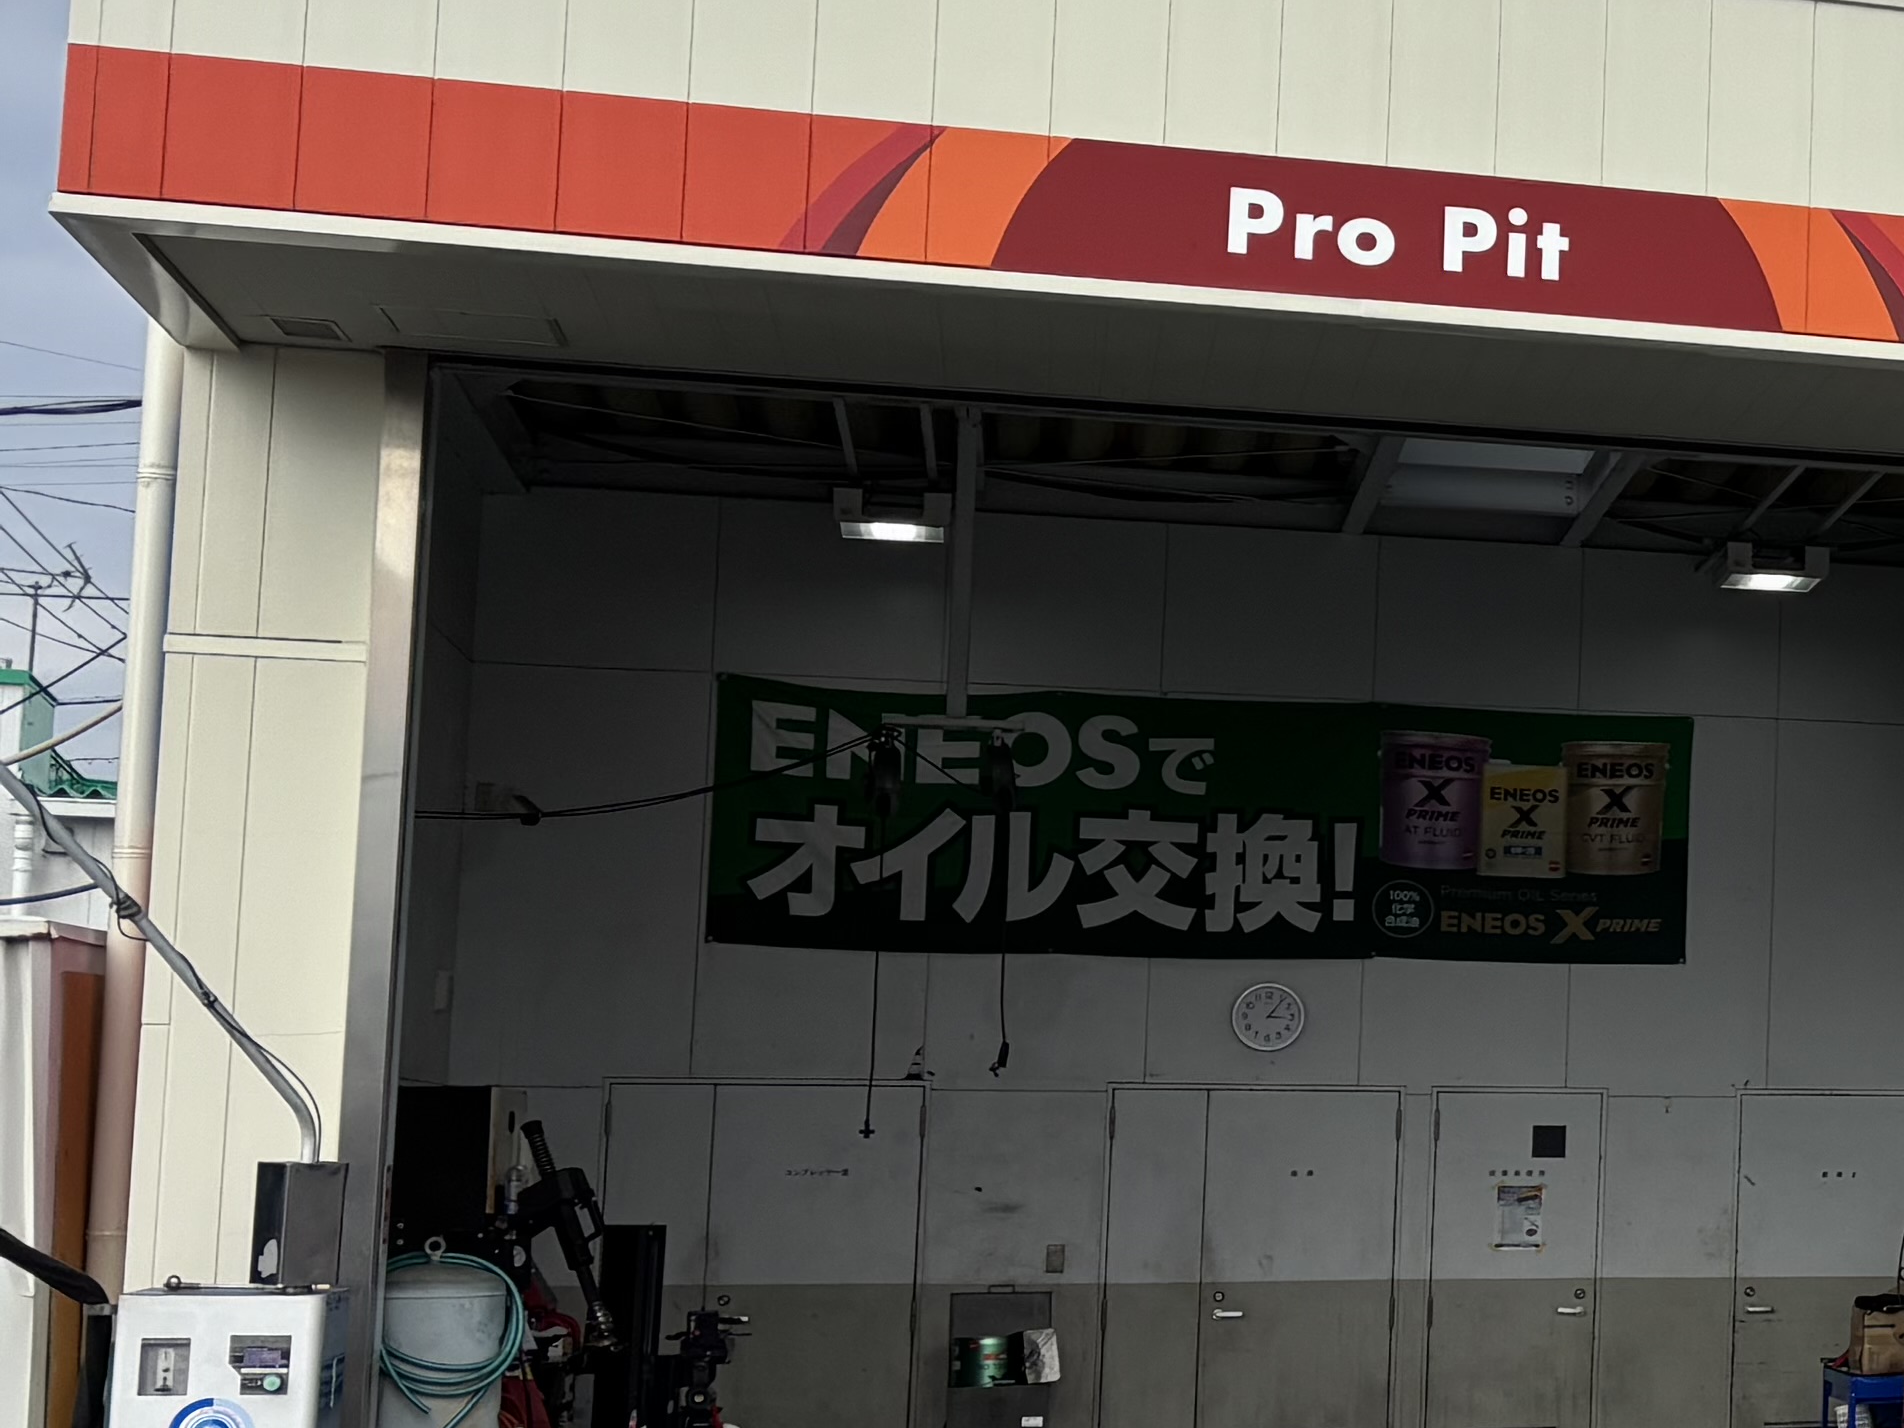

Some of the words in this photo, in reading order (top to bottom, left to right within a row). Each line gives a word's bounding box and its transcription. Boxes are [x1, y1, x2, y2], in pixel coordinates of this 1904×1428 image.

[1226, 186, 1397, 268] Pro
[1442, 204, 1573, 283] Pit
[750, 700, 1214, 795] ENEOSで
[1395, 751, 1475, 773] ENEOS
[1576, 762, 1654, 780] ENEOS
[1412, 778, 1455, 807] X
[1489, 786, 1559, 804] ENEOS
[1595, 785, 1635, 815] X
[1405, 808, 1460, 822] PRIME
[1506, 804, 1540, 828] X
[1587, 816, 1640, 829] PRIME
[1501, 829, 1546, 840] PRIME
[746, 804, 1358, 934] オイル交換!
[1440, 910, 1546, 936] ENEOS
[1549, 906, 1600, 945] X
[1595, 918, 1663, 933] PRIME
